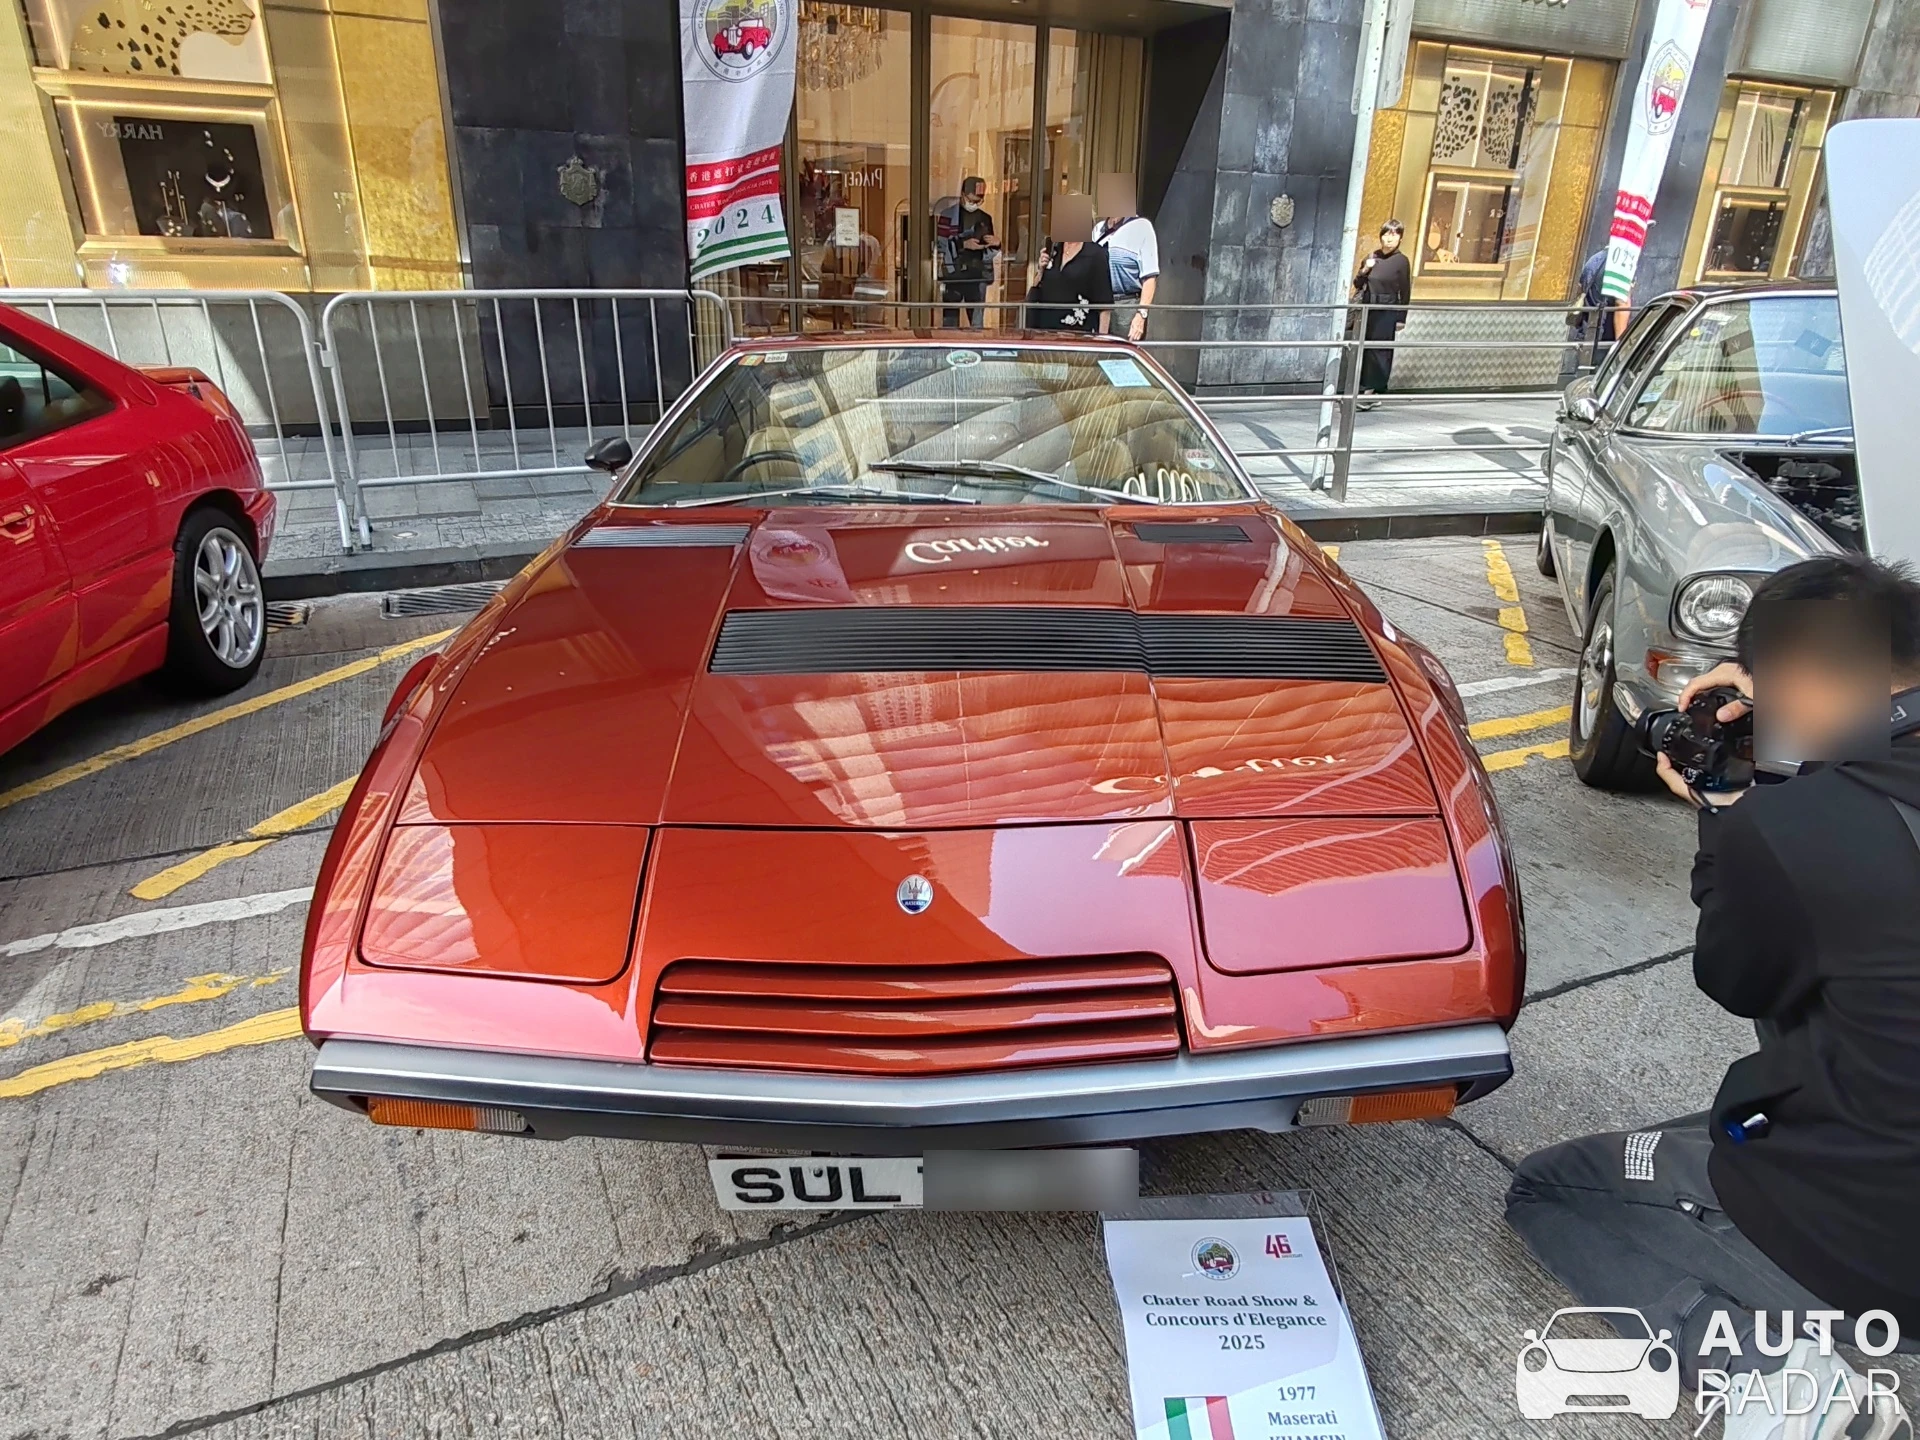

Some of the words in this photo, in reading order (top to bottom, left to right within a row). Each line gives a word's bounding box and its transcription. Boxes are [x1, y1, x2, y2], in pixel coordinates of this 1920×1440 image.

[696, 204, 776, 248] 2024
[731, 1166, 902, 1204] SUL
[1265, 1234, 1292, 1258] 46
[1142, 1294, 1199, 1307] Chater
[1205, 1294, 1249, 1307] Road
[1253, 1294, 1297, 1307] Show
[1303, 1294, 1318, 1307] &
[1146, 1312, 1229, 1327] Concours
[1233, 1312, 1327, 1330] d'Elegance
[1218, 1334, 1266, 1350] 2025
[1277, 1386, 1316, 1401] 1977
[1267, 1410, 1338, 1426] Maserati
